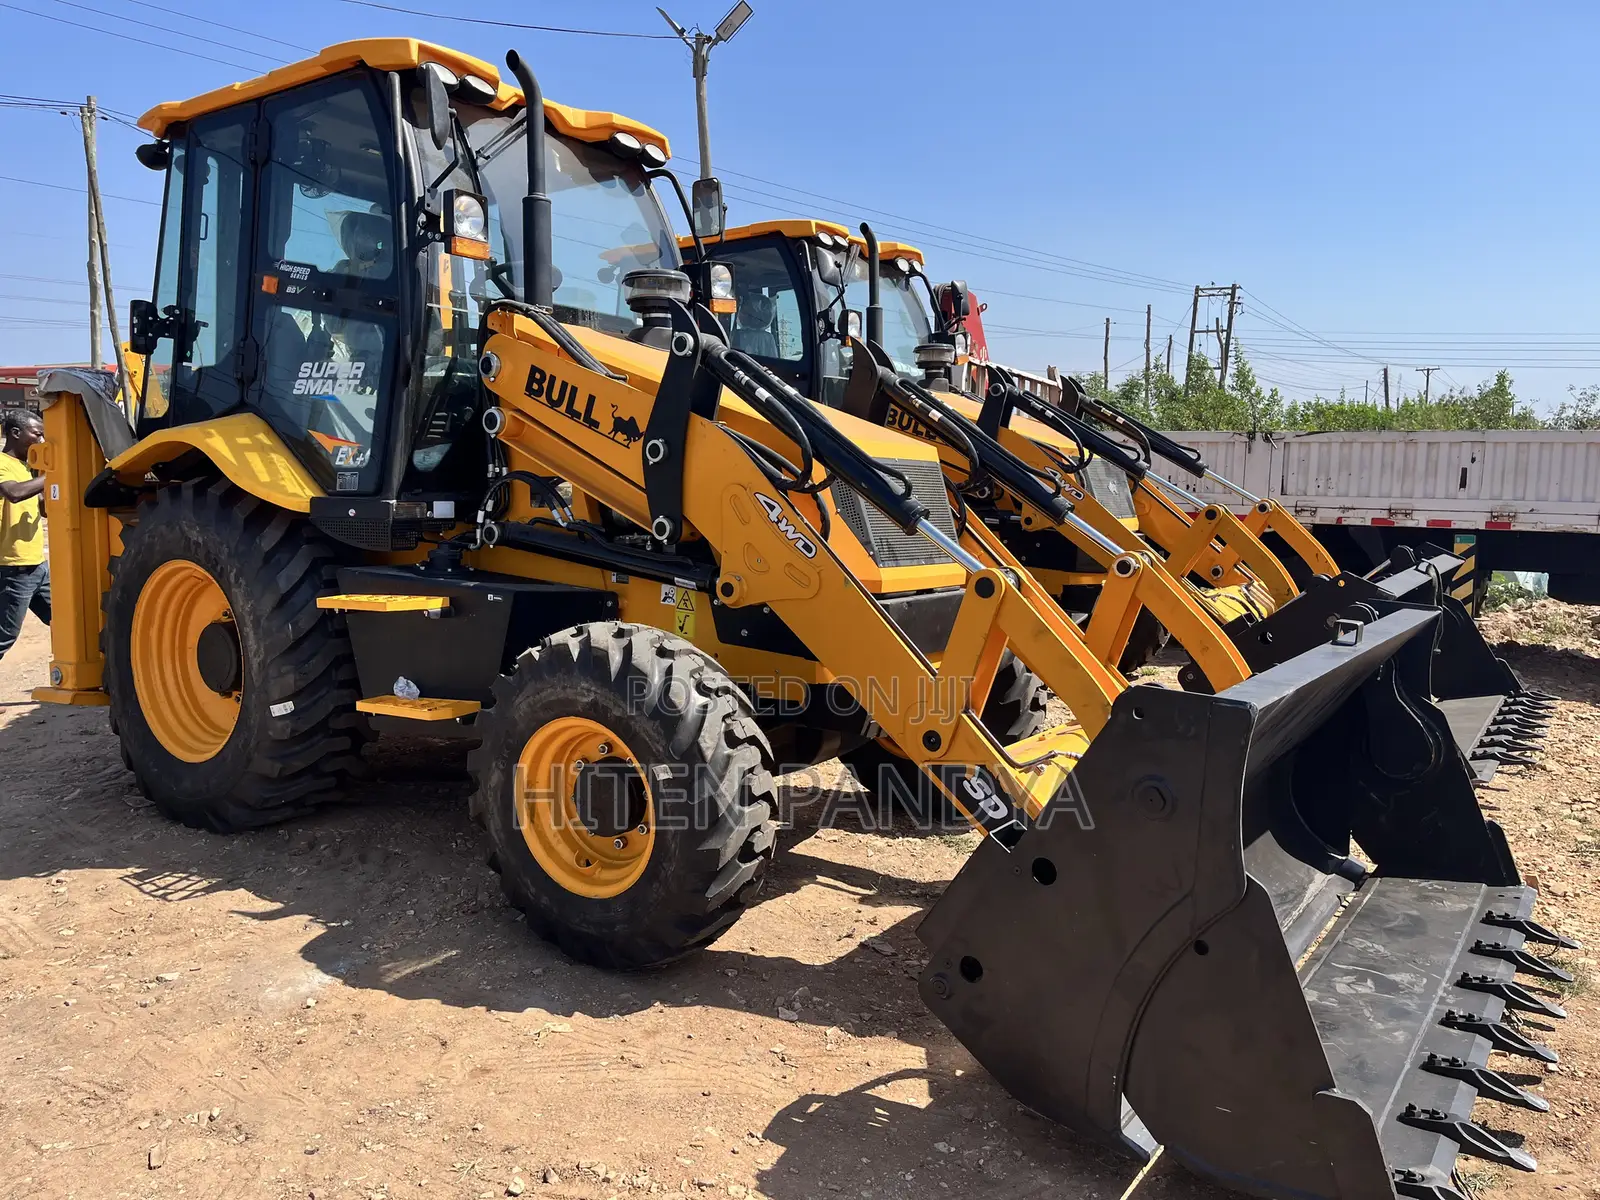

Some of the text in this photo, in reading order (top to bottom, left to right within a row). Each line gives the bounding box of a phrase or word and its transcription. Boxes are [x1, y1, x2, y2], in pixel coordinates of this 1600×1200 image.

[280, 263, 311, 275] HIGH SPEED
[298, 361, 365, 379] SUPER
[292, 379, 361, 396] SMART
[524, 364, 601, 430] BULL
[1044, 466, 1085, 501] 4WD
[754, 492, 817, 559] 4WD
